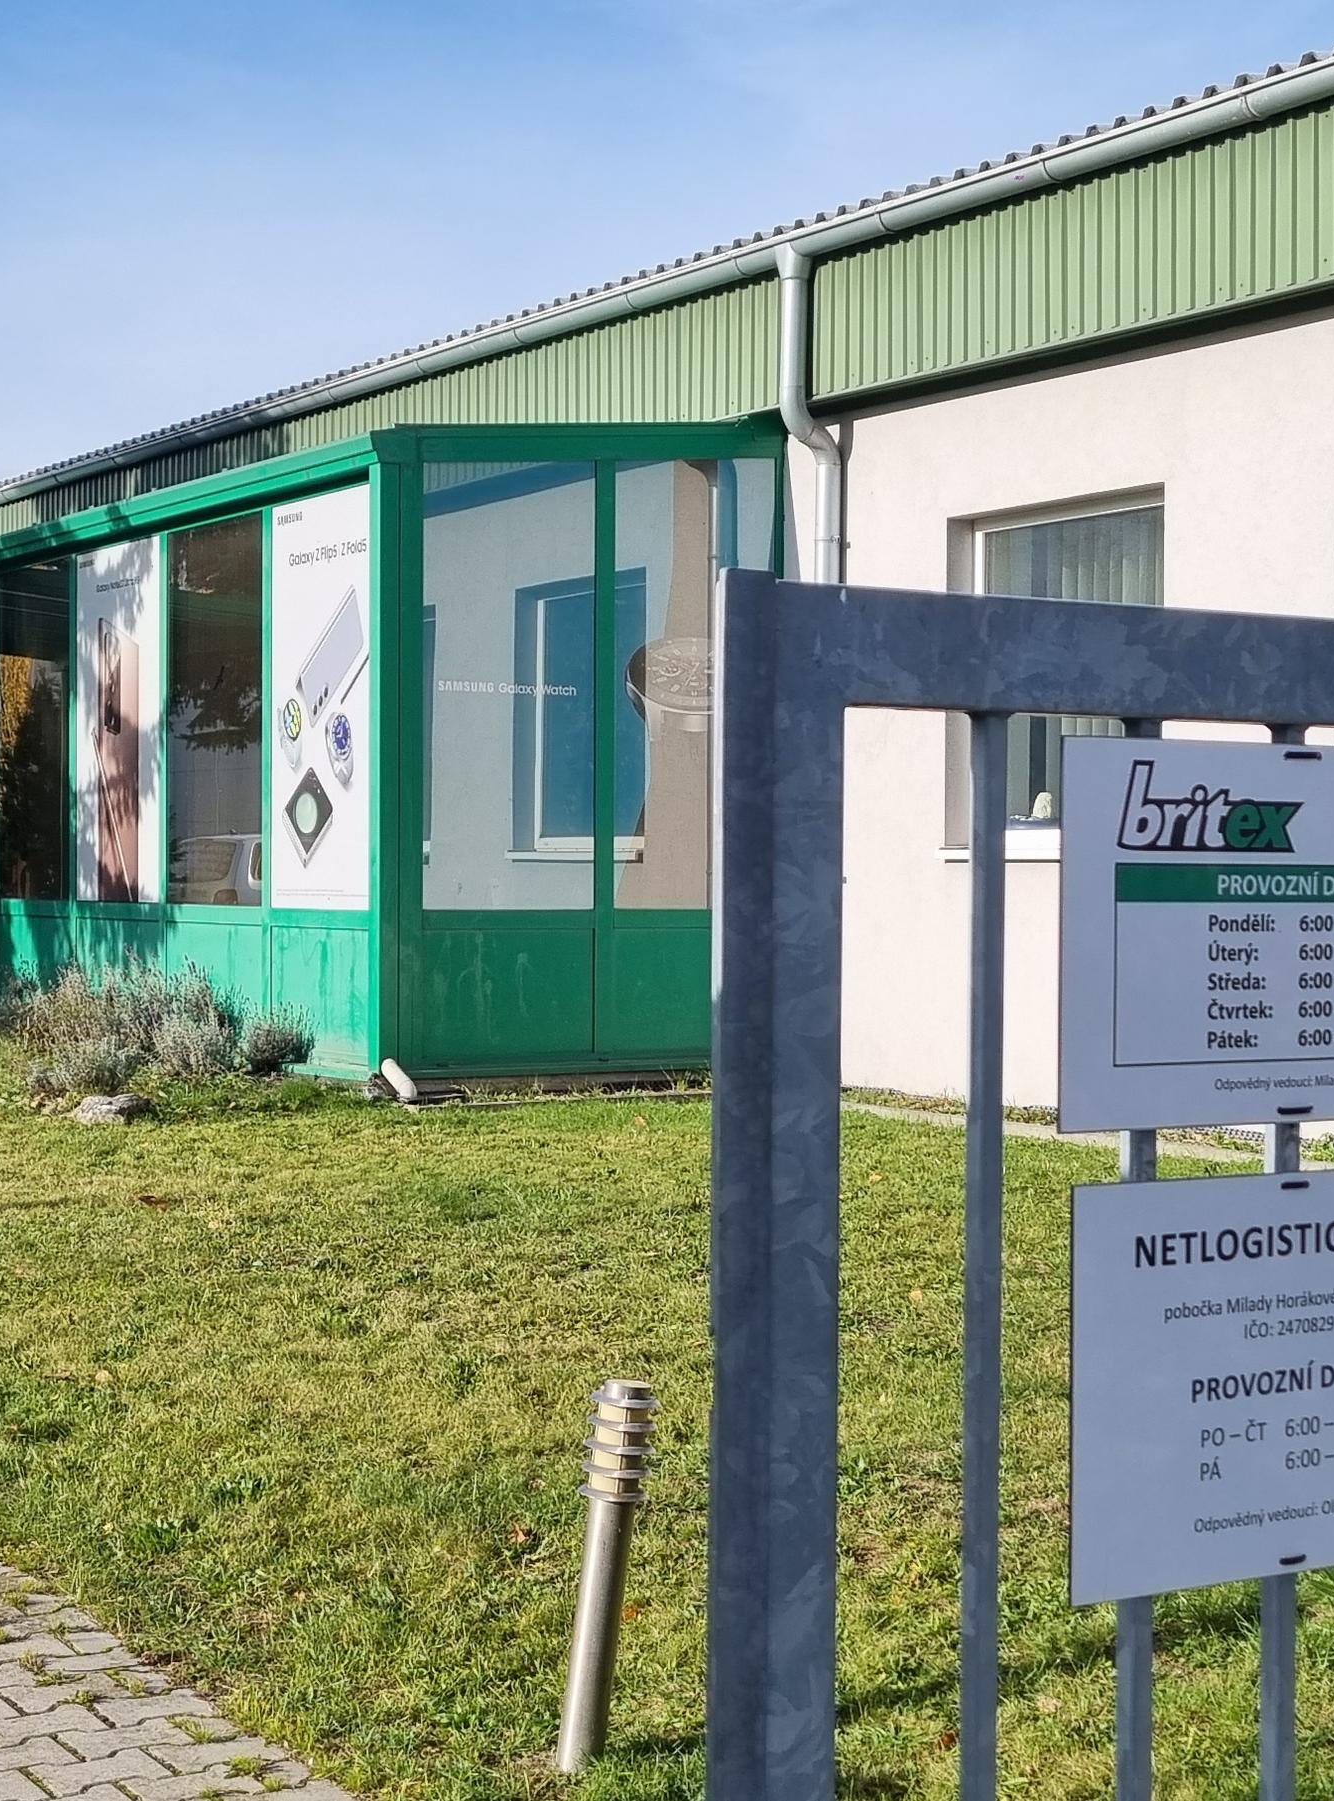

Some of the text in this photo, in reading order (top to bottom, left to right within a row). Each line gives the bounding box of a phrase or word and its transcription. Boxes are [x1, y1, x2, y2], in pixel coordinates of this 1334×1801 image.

[289, 539, 367, 566] Galaxy Z Flip5 Z Fold5
[438, 680, 577, 697] SAMSUNG Galaxy Watch
[1117, 759, 1305, 853] britex
[1217, 872, 1321, 897] PROVOZNÍ
[1207, 912, 1276, 934] Pondělí:
[1298, 915, 1332, 933] 6:00
[1207, 940, 1259, 964] Úterý:
[1298, 943, 1332, 962] 6:00
[1207, 971, 1266, 991] Středa:
[1298, 972, 1332, 990] 6:00
[1207, 999, 1274, 1020] Čtvrtek:
[1298, 1000, 1332, 1019] 6:00
[1207, 1029, 1258, 1049] Pátek:
[1298, 1028, 1332, 1047] 6:00
[1214, 1074, 1271, 1090] Odpovědný
[1273, 1074, 1313, 1088] vedoucí:
[1164, 1299, 1222, 1324] pobočka
[1227, 1295, 1272, 1316] Milady
[1244, 1320, 1275, 1340] IČO:
[1191, 1360, 1313, 1403] PROVOZNÍ
[1201, 1426, 1225, 1447] PO
[1244, 1418, 1267, 1442] ČT
[1285, 1415, 1321, 1438] 6:00
[1200, 1456, 1222, 1481] PÁ
[1285, 1447, 1321, 1471] 6:00
[1194, 1512, 1265, 1534] Odpovědný
[1267, 1504, 1318, 1522] vedoucí:
